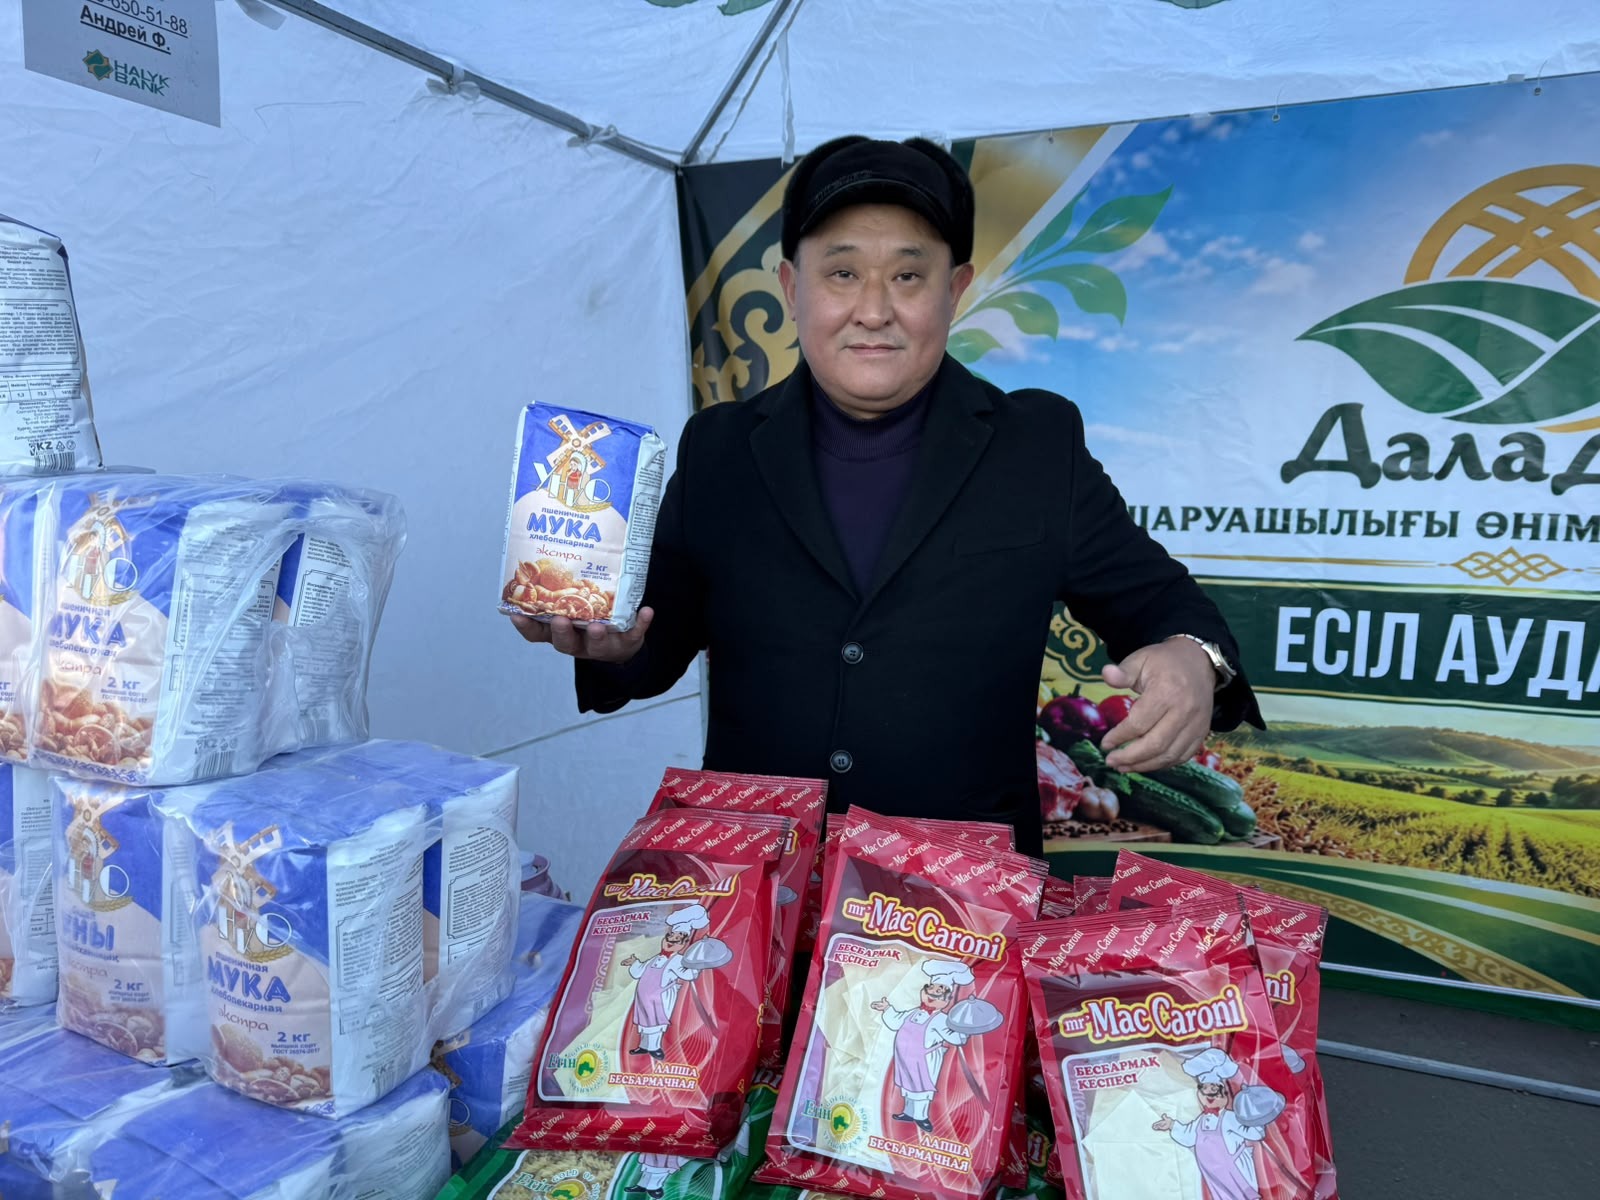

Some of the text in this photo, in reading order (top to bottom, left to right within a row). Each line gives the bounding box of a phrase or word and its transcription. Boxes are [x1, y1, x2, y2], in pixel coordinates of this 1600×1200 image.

[80, 5, 171, 51] Андрей Ф.
[114, 60, 170, 88] HALYK
[114, 72, 165, 97] BANK
[541, 507, 590, 520] пшеничная
[526, 512, 602, 543] МУКА
[1476, 511, 1600, 542] ӨНІМ
[529, 533, 595, 549] хлебопекарная
[536, 543, 582, 562] экстра
[586, 562, 593, 570] 2
[1275, 605, 1420, 681] ЕСІЛ
[107, 677, 140, 690] 2 кг
[592, 925, 631, 935] КЕСПЕСІ
[216, 952, 269, 973] пшеничная
[834, 953, 879, 968] КЕСПЕСІ
[114, 979, 143, 991] 2 кг
[207, 955, 291, 1004] МУКА
[211, 985, 283, 1013] хлебопекарная
[218, 1004, 269, 1033] экстра
[277, 1031, 311, 1042] 2 кг
[654, 1064, 697, 1077] ЛАПША
[608, 1074, 695, 1089] БЕСБАРМАЧНАЯ
[1078, 1073, 1138, 1090] КЕСПЕСІ
[868, 1137, 970, 1171] БЕСБАРМАЧНАЯ
[922, 1137, 971, 1157] ЛАПША
